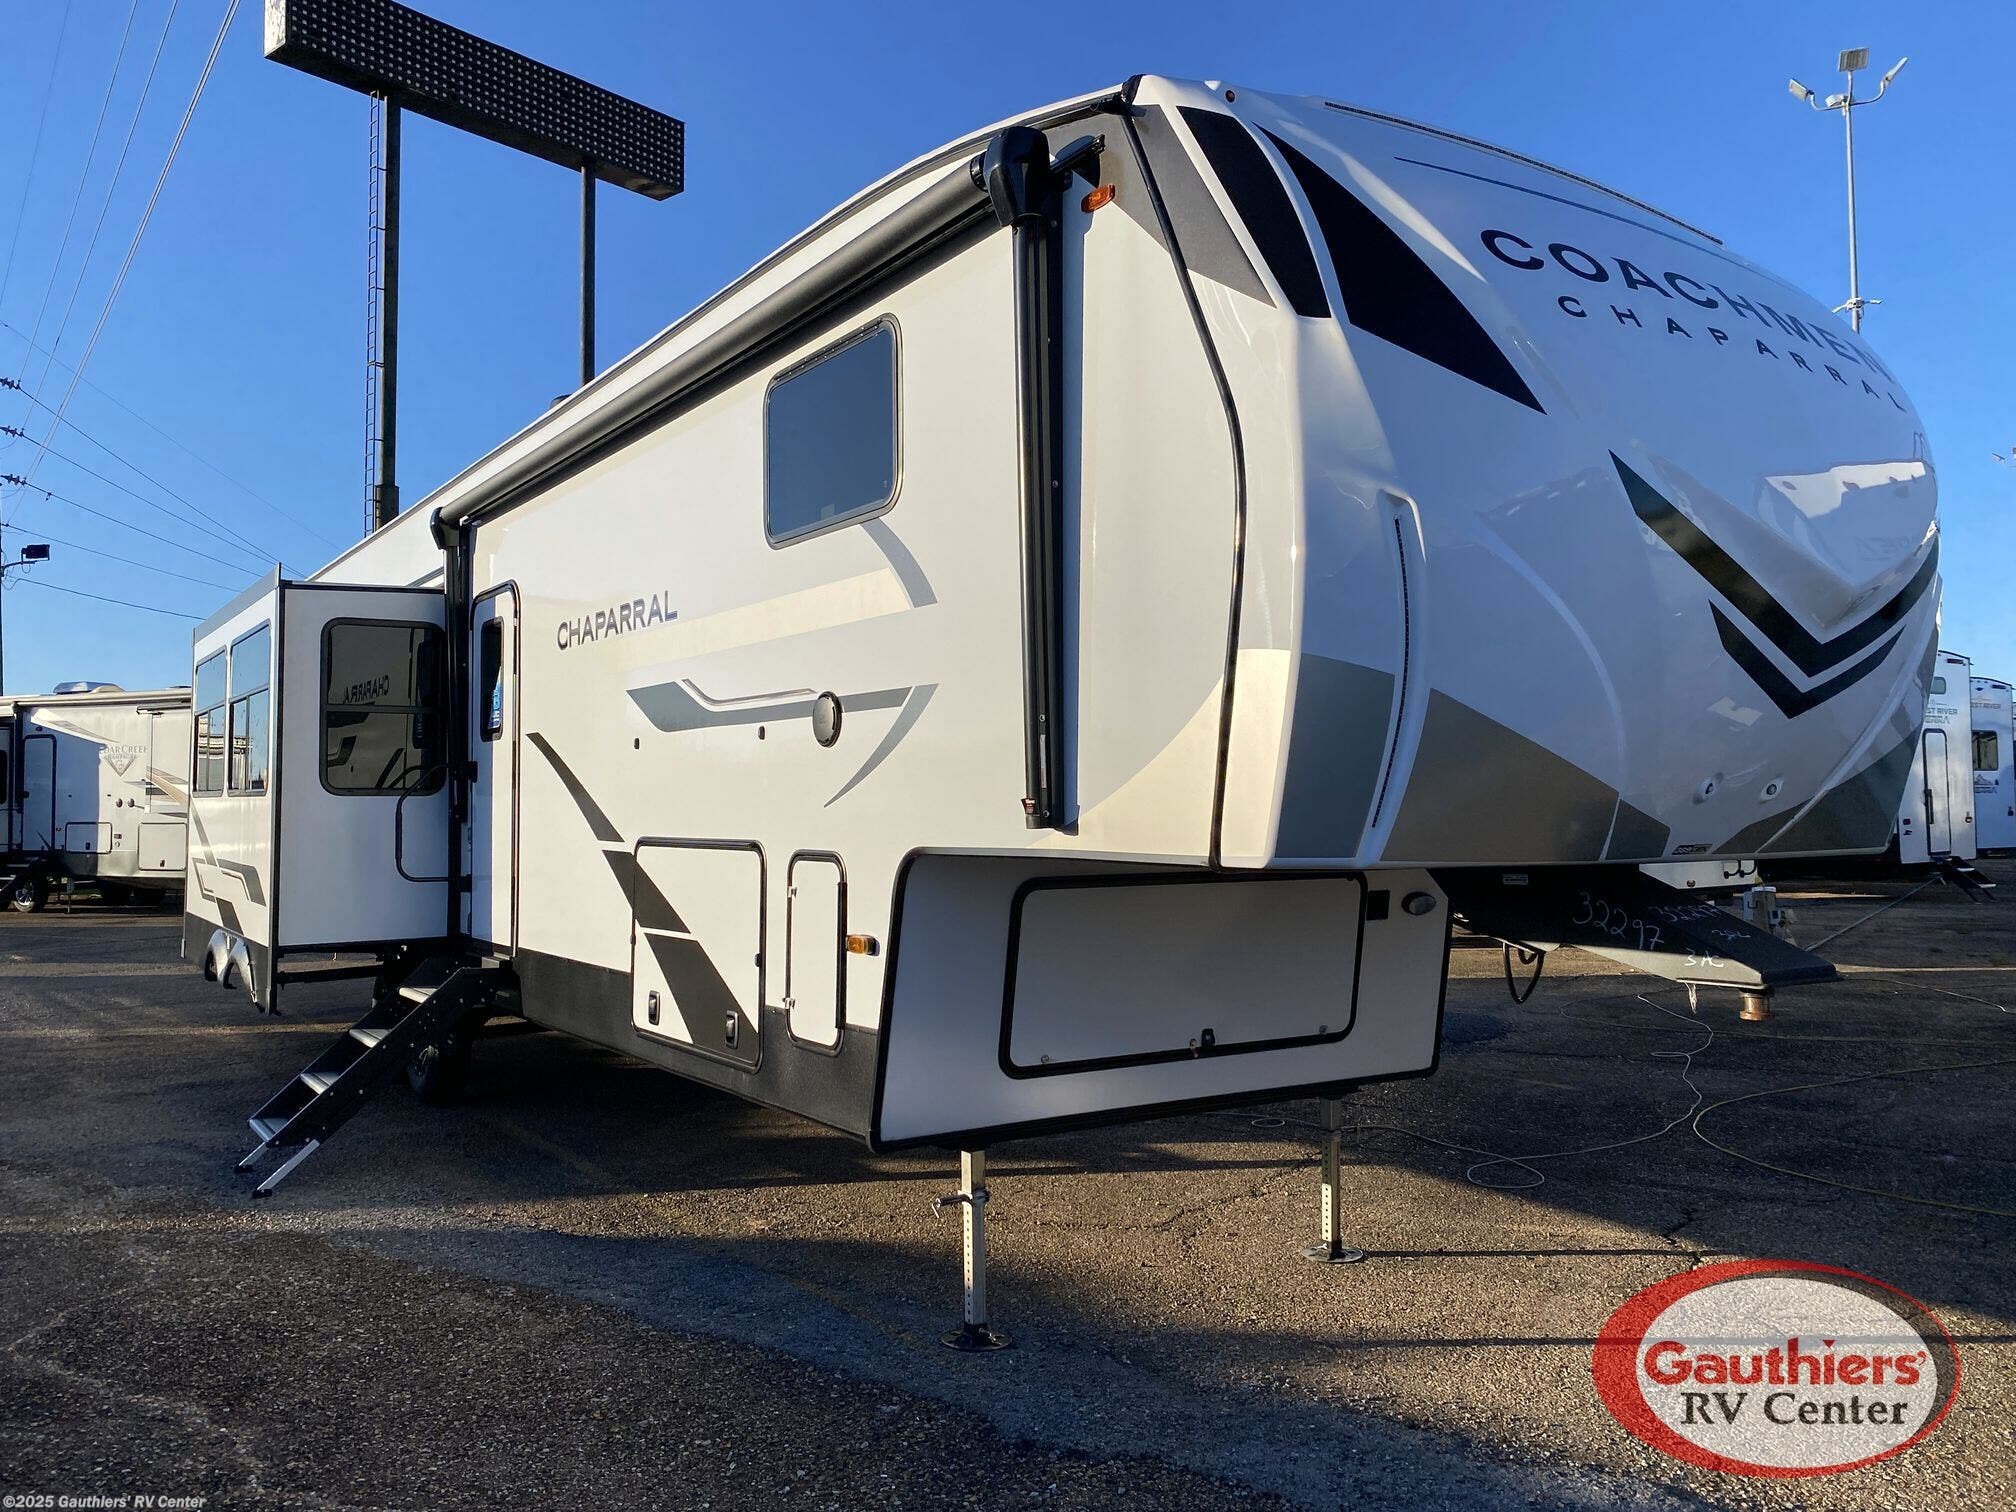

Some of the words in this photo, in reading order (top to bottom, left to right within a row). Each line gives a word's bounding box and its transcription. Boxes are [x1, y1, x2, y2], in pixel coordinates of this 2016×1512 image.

[1480, 229, 1894, 384] COACHMEN
[1557, 295, 1908, 413] CHAPARRAL
[557, 590, 678, 651] CHAPARRAL
[1572, 891, 1664, 950] 32297
